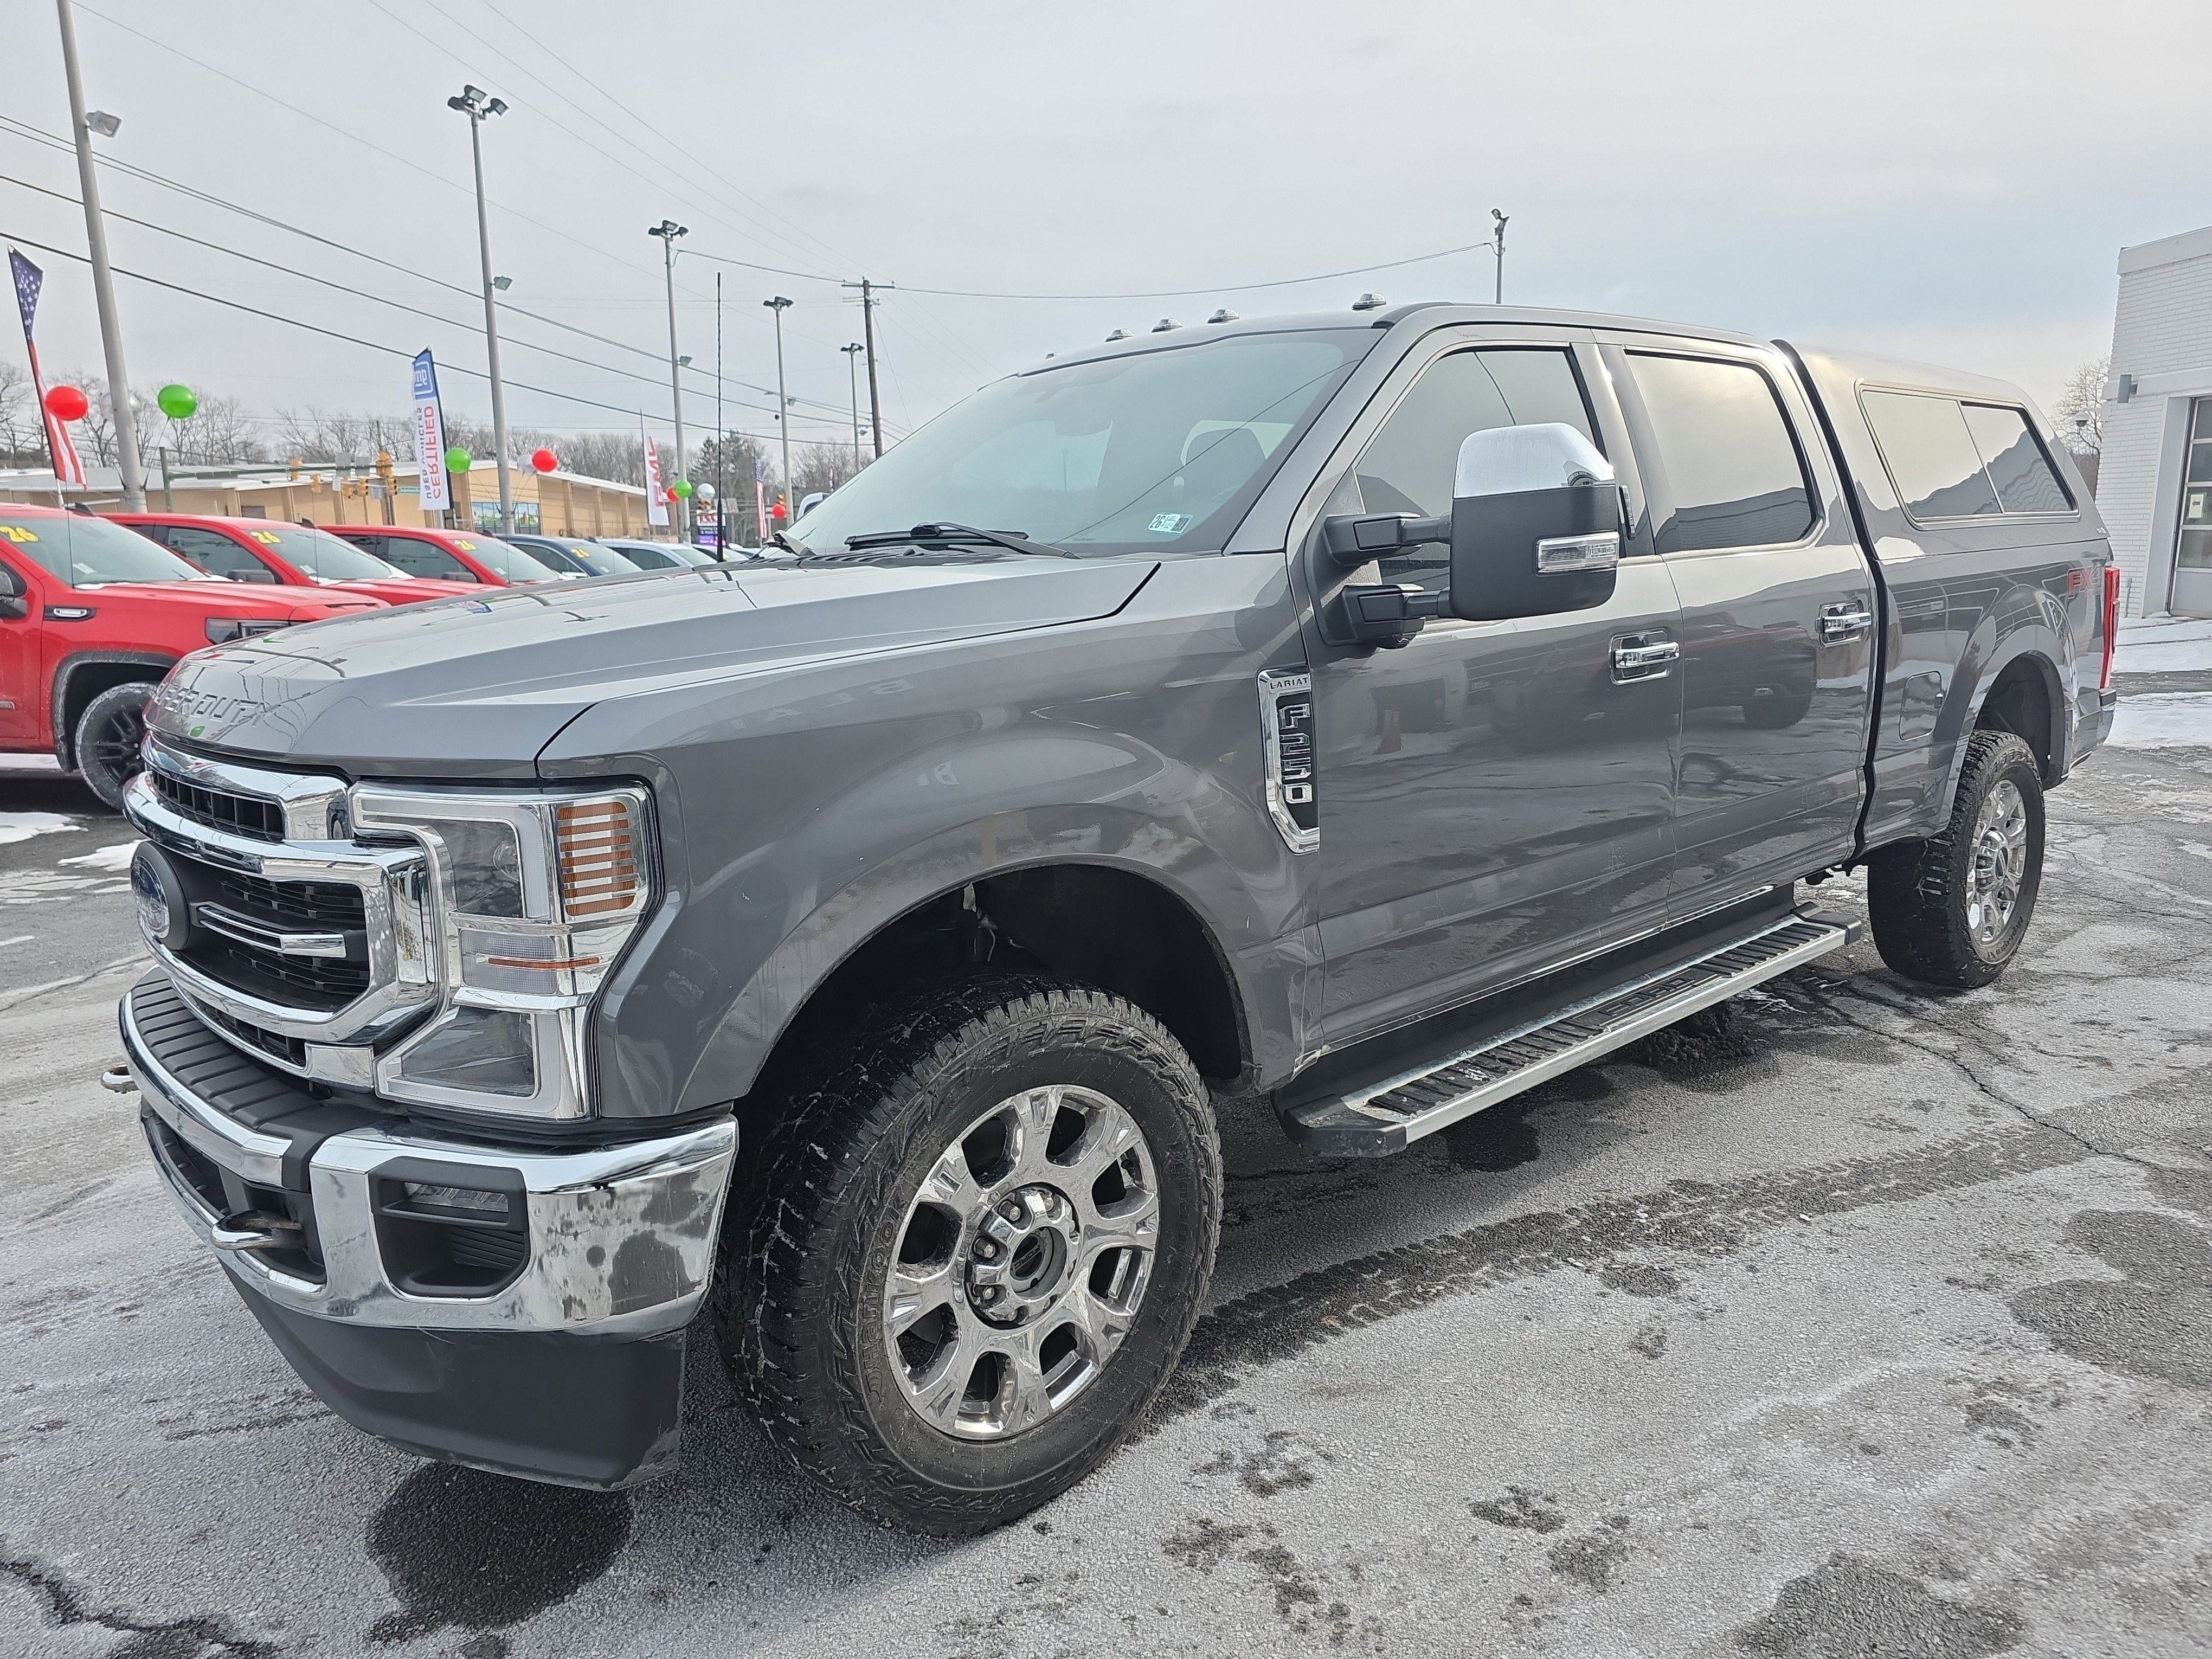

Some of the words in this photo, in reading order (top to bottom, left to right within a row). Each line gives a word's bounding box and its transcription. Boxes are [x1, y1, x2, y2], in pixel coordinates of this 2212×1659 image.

[1150, 515, 1166, 529] 26
[250, 531, 281, 543] 26
[2067, 564, 2102, 600] FX4
[1270, 677, 1309, 690] LARIAT
[190, 694, 282, 728] DUTY
[1598, 978, 1687, 1017] FORD
